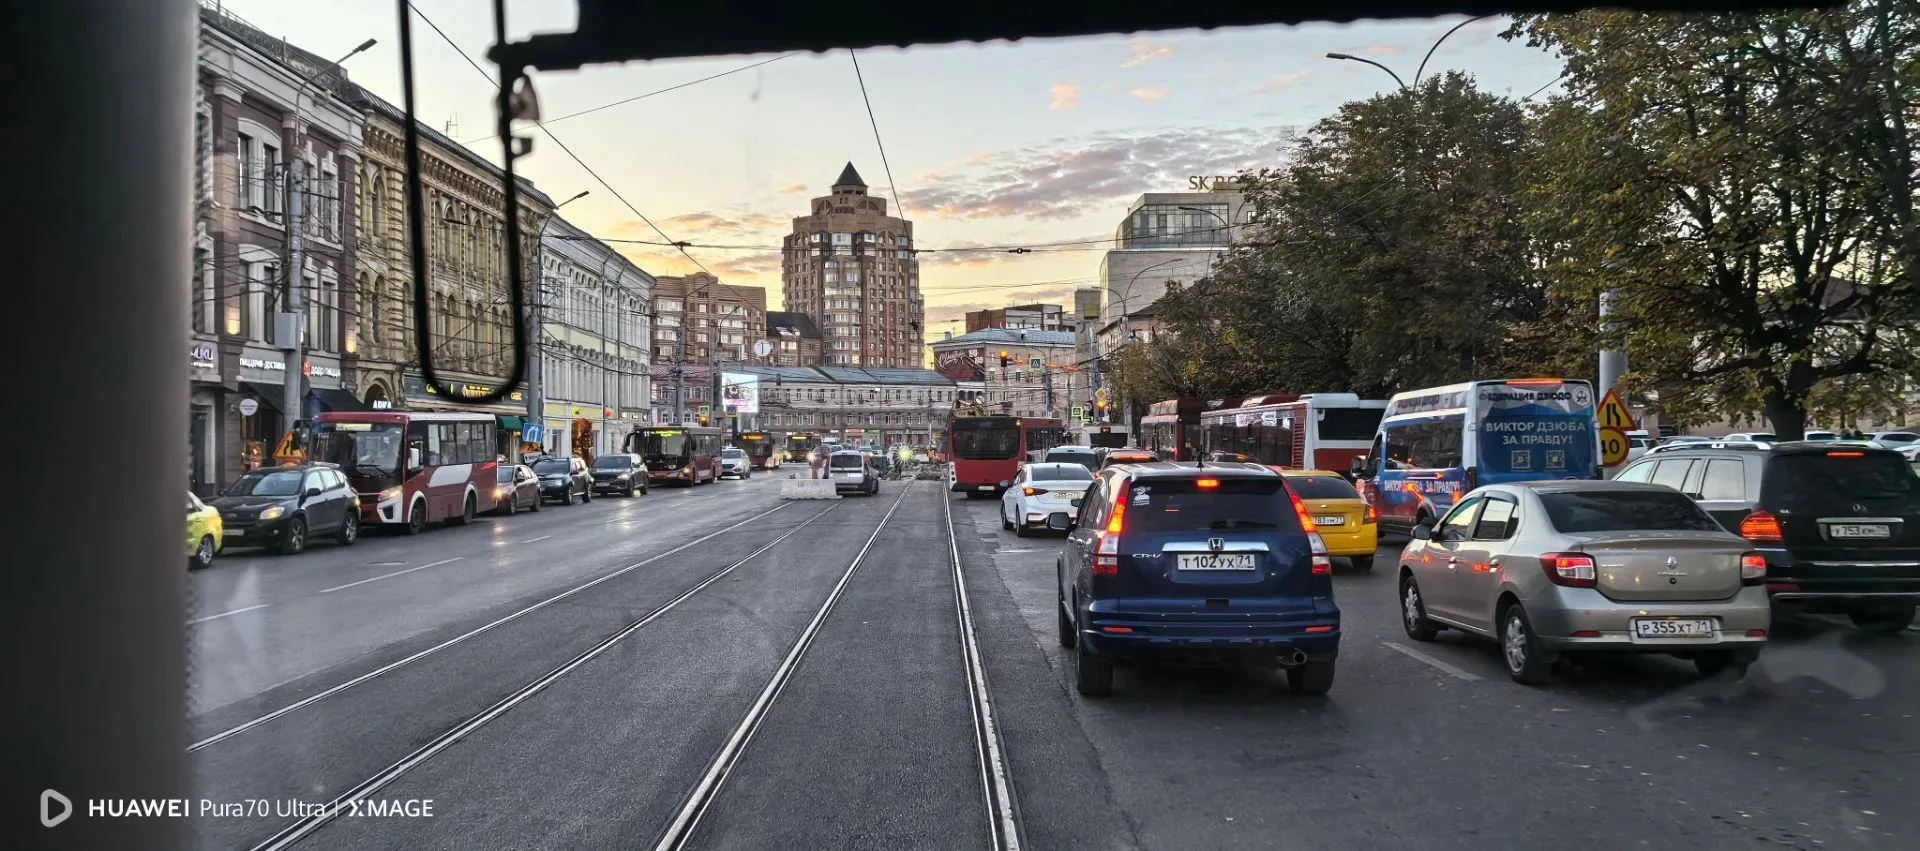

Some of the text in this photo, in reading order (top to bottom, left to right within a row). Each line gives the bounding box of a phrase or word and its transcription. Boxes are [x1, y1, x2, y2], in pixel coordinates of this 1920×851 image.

[1188, 175, 1209, 190] SK
[1486, 421, 1586, 433] ВИКТОР ДЗЮБА
[1502, 435, 1573, 446] ЗА ПРАВДУ!
